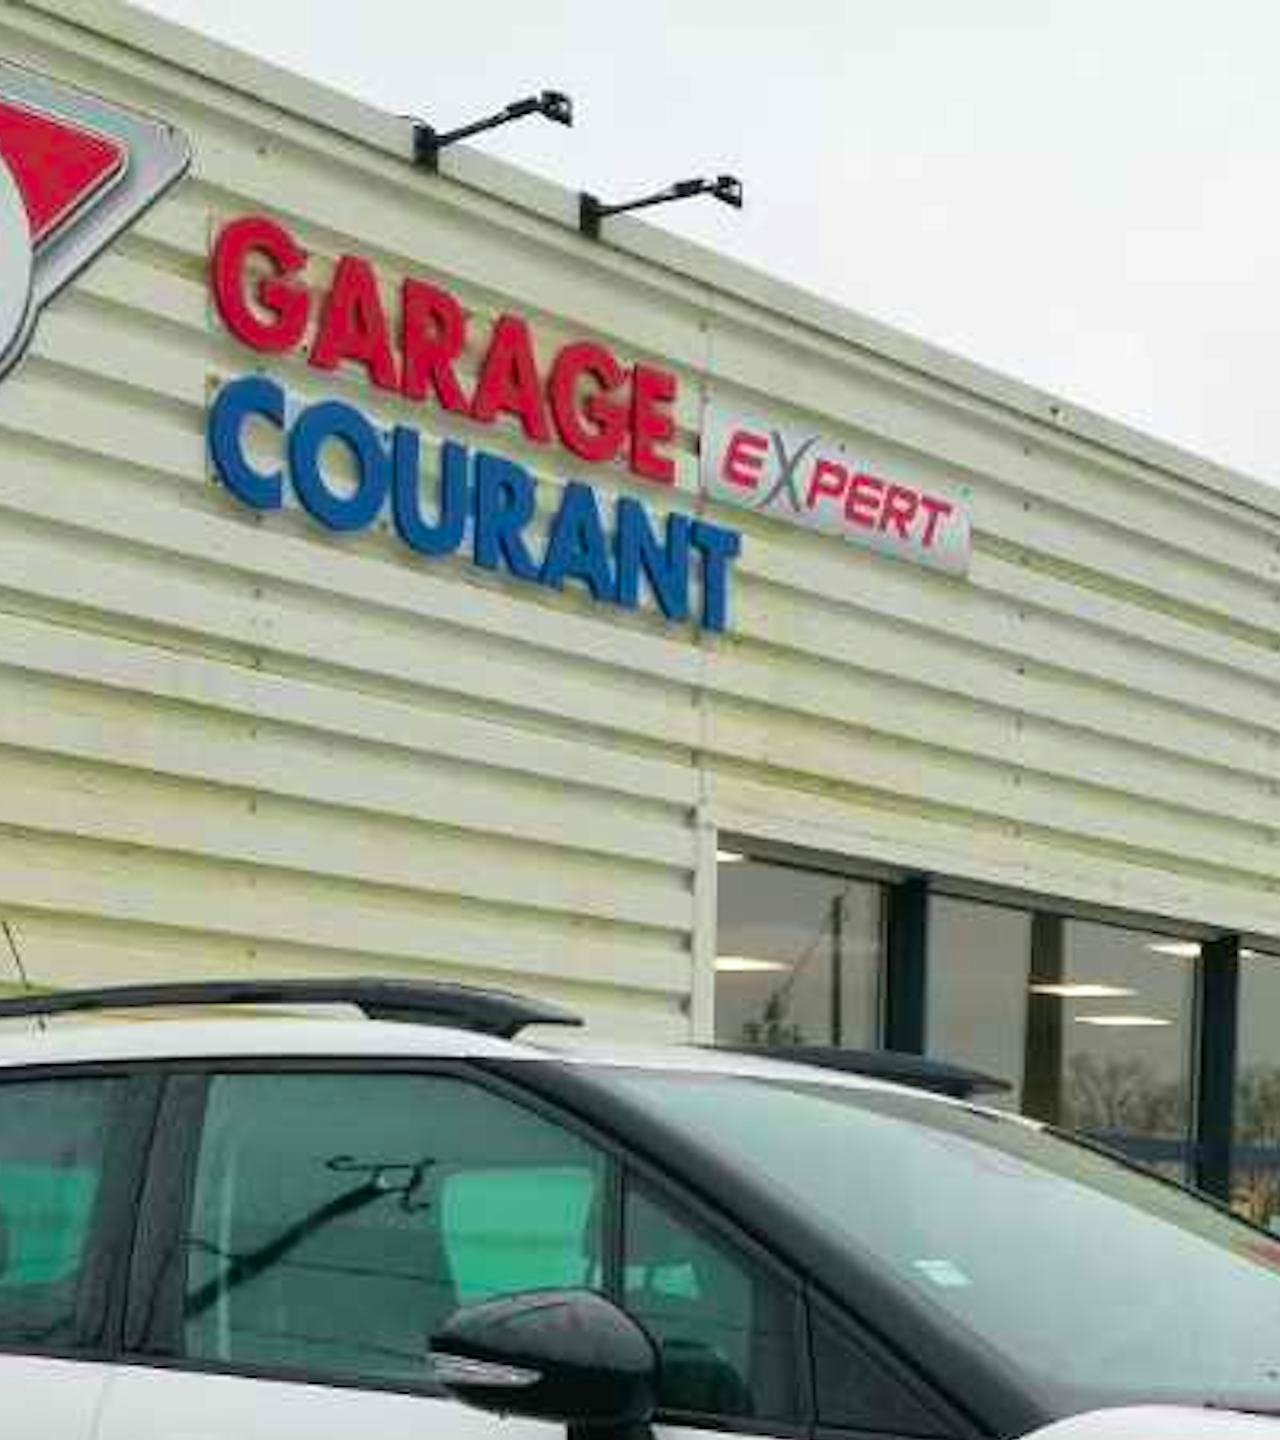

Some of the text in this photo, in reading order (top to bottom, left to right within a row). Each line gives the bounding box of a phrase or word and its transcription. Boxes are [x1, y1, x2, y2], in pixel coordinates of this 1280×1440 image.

[210, 213, 678, 484] GARAGE
[208, 374, 742, 634] COURANT
[722, 427, 952, 549] EXPERT
